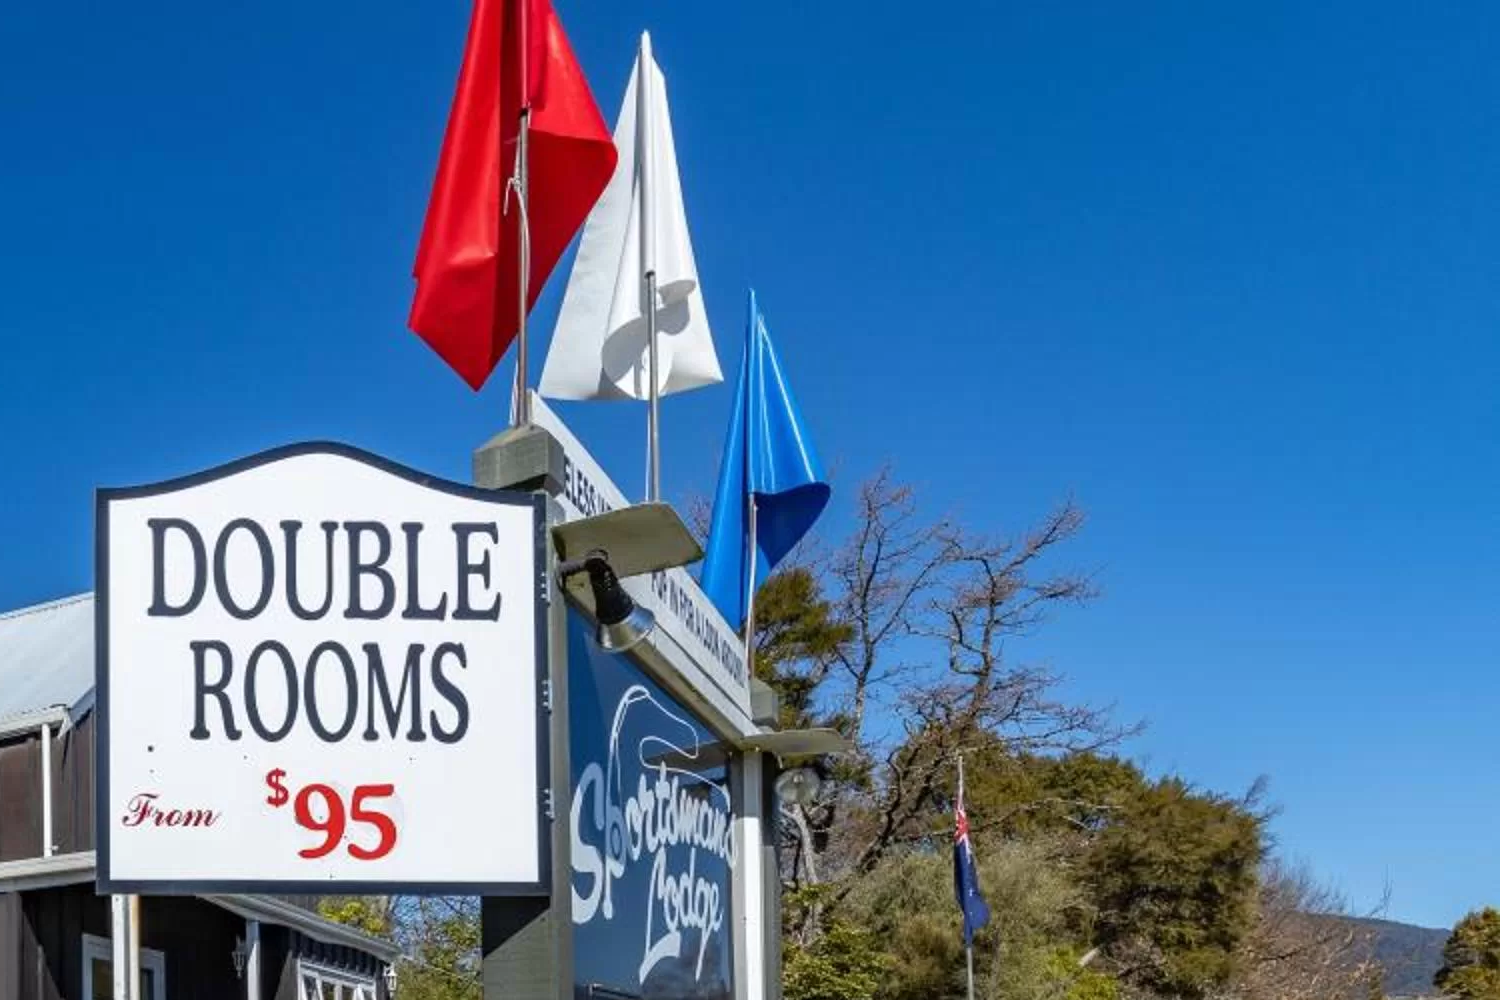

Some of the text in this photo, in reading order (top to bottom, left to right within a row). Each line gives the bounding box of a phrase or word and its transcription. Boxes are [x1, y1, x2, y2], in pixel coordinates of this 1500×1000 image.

[147, 517, 502, 622] DOUBLE
[189, 639, 470, 745] ROOMS
[121, 767, 397, 861] From $95
[639, 844, 725, 985] Lodge
